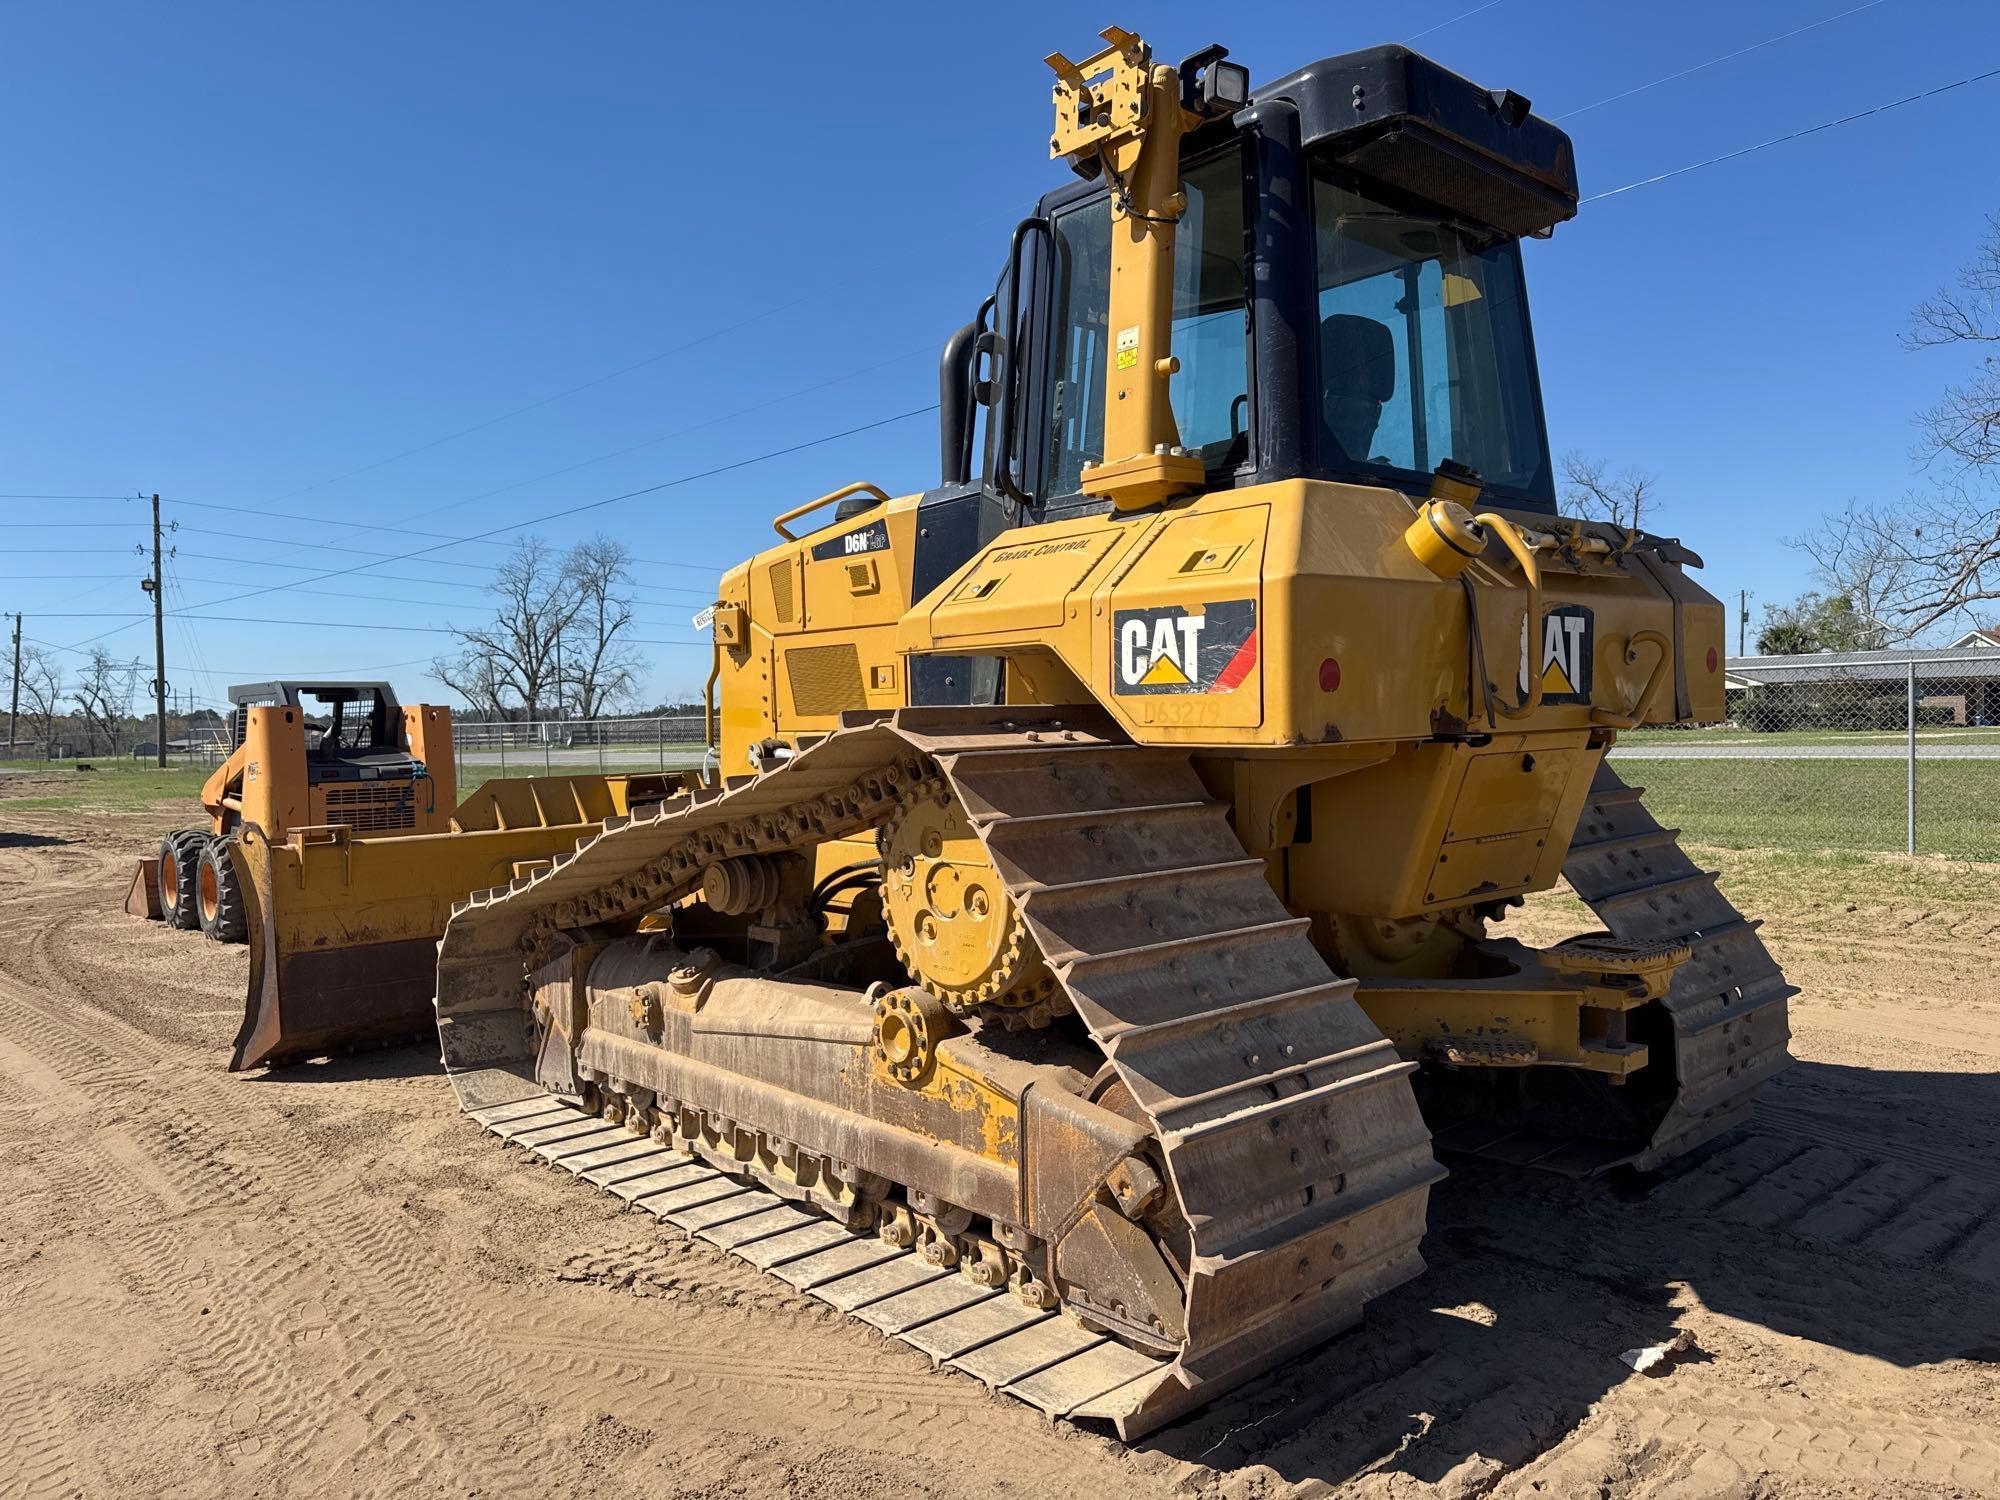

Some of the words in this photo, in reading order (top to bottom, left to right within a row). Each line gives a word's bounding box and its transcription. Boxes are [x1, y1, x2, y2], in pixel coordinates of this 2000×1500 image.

[845, 532, 867, 554] D6N
[993, 549, 1035, 563] GRADE
[1034, 540, 1091, 556] CONTROL
[1121, 616, 1205, 685] CAT
[1520, 613, 1585, 693] AT
